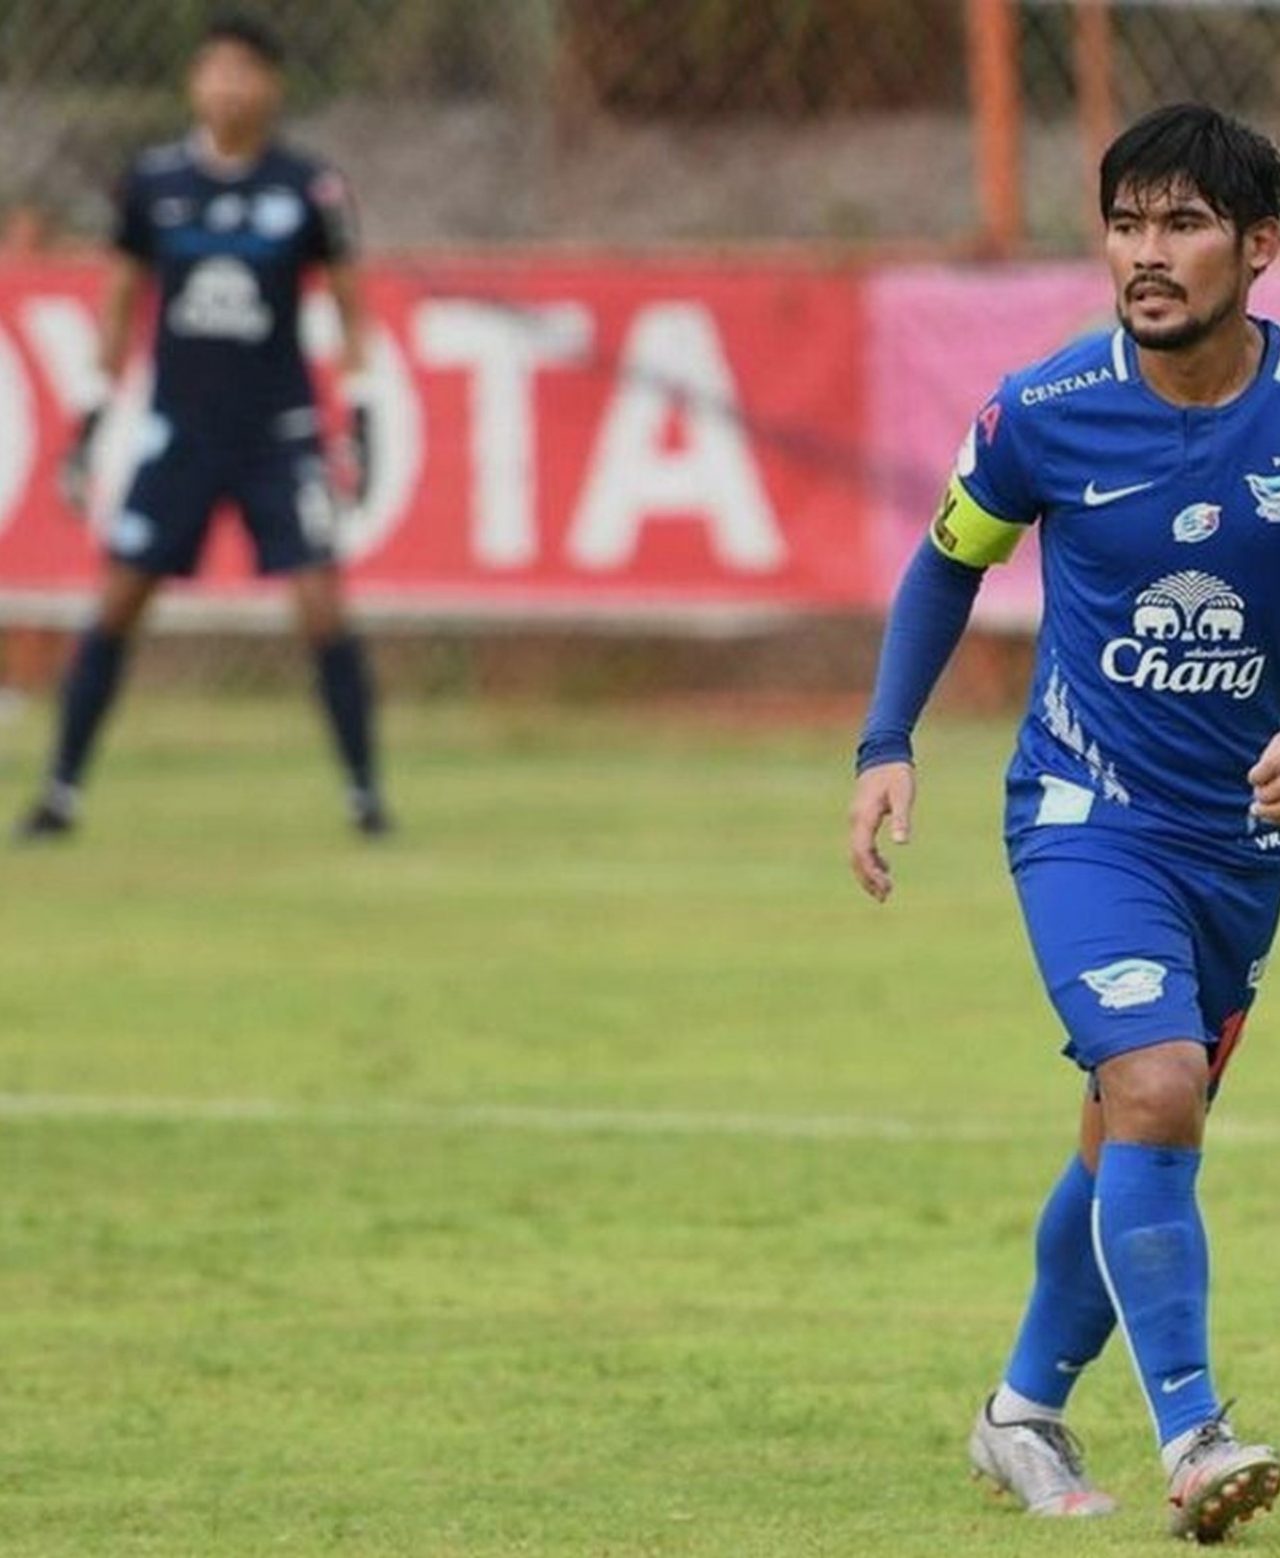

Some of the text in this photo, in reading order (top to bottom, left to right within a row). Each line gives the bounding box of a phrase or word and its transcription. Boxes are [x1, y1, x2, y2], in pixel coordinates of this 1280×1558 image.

[1021, 367, 1112, 406] CENTARA
[0, 295, 786, 570] YOTA
[1101, 637, 1266, 699] Chang
